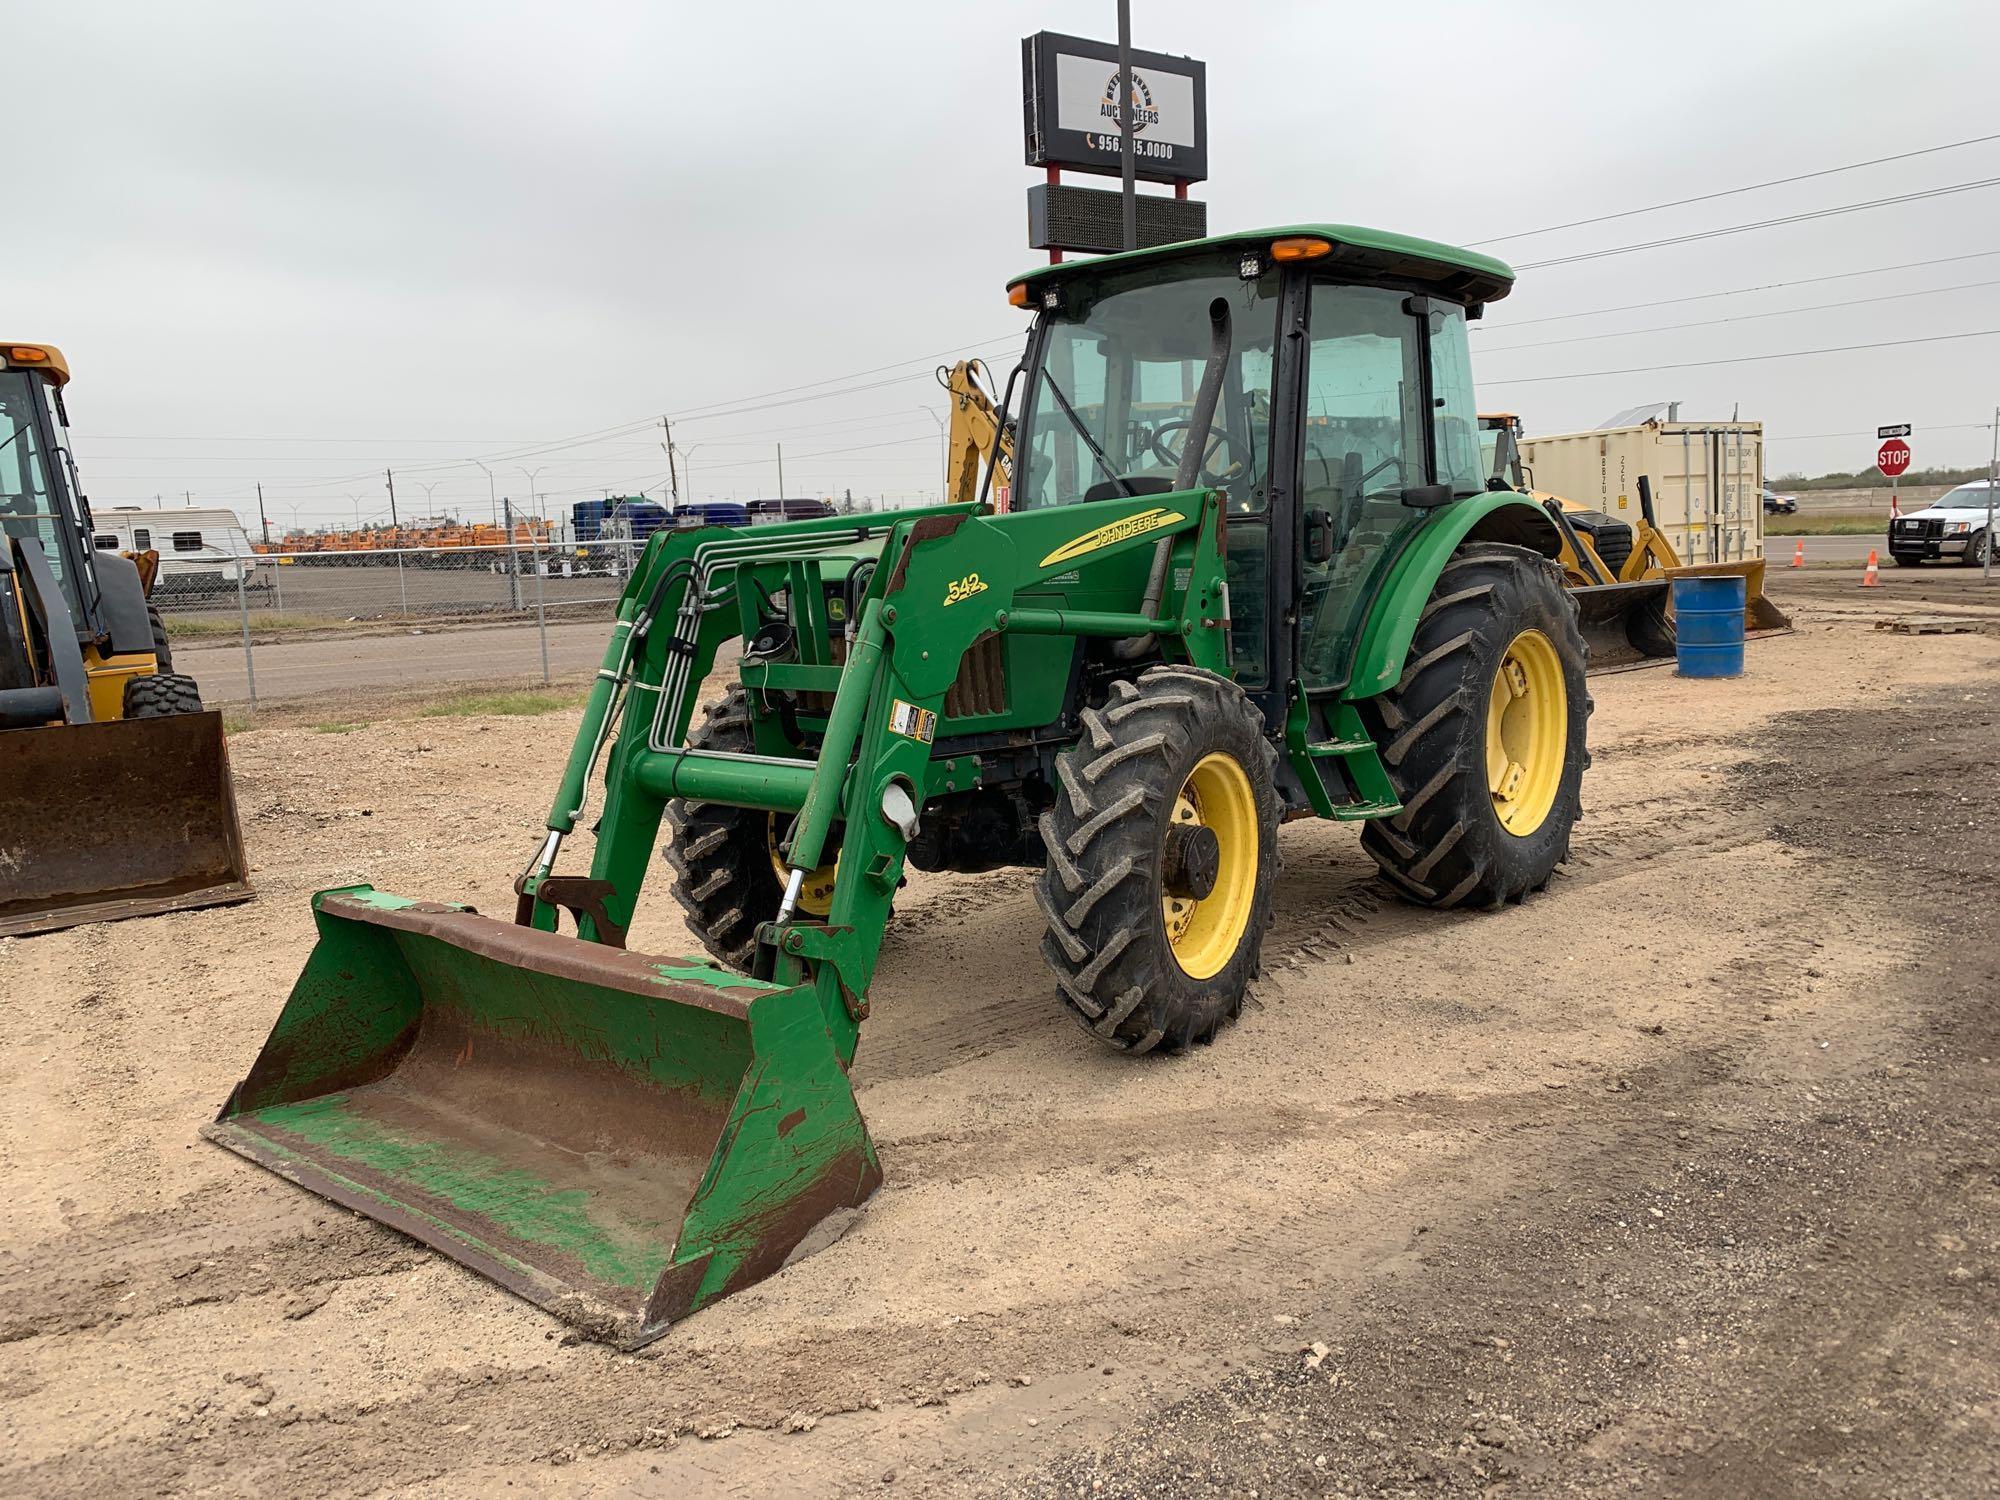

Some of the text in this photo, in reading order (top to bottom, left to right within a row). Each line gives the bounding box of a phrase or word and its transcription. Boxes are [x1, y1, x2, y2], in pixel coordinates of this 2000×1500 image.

[1100, 103, 1159, 124] AUCTNEERS
[1098, 135, 1173, 159] 956.5.0000
[1879, 450, 1909, 466] STOP
[1095, 514, 1159, 547] JOHN DEERE
[948, 573, 981, 601] 542
